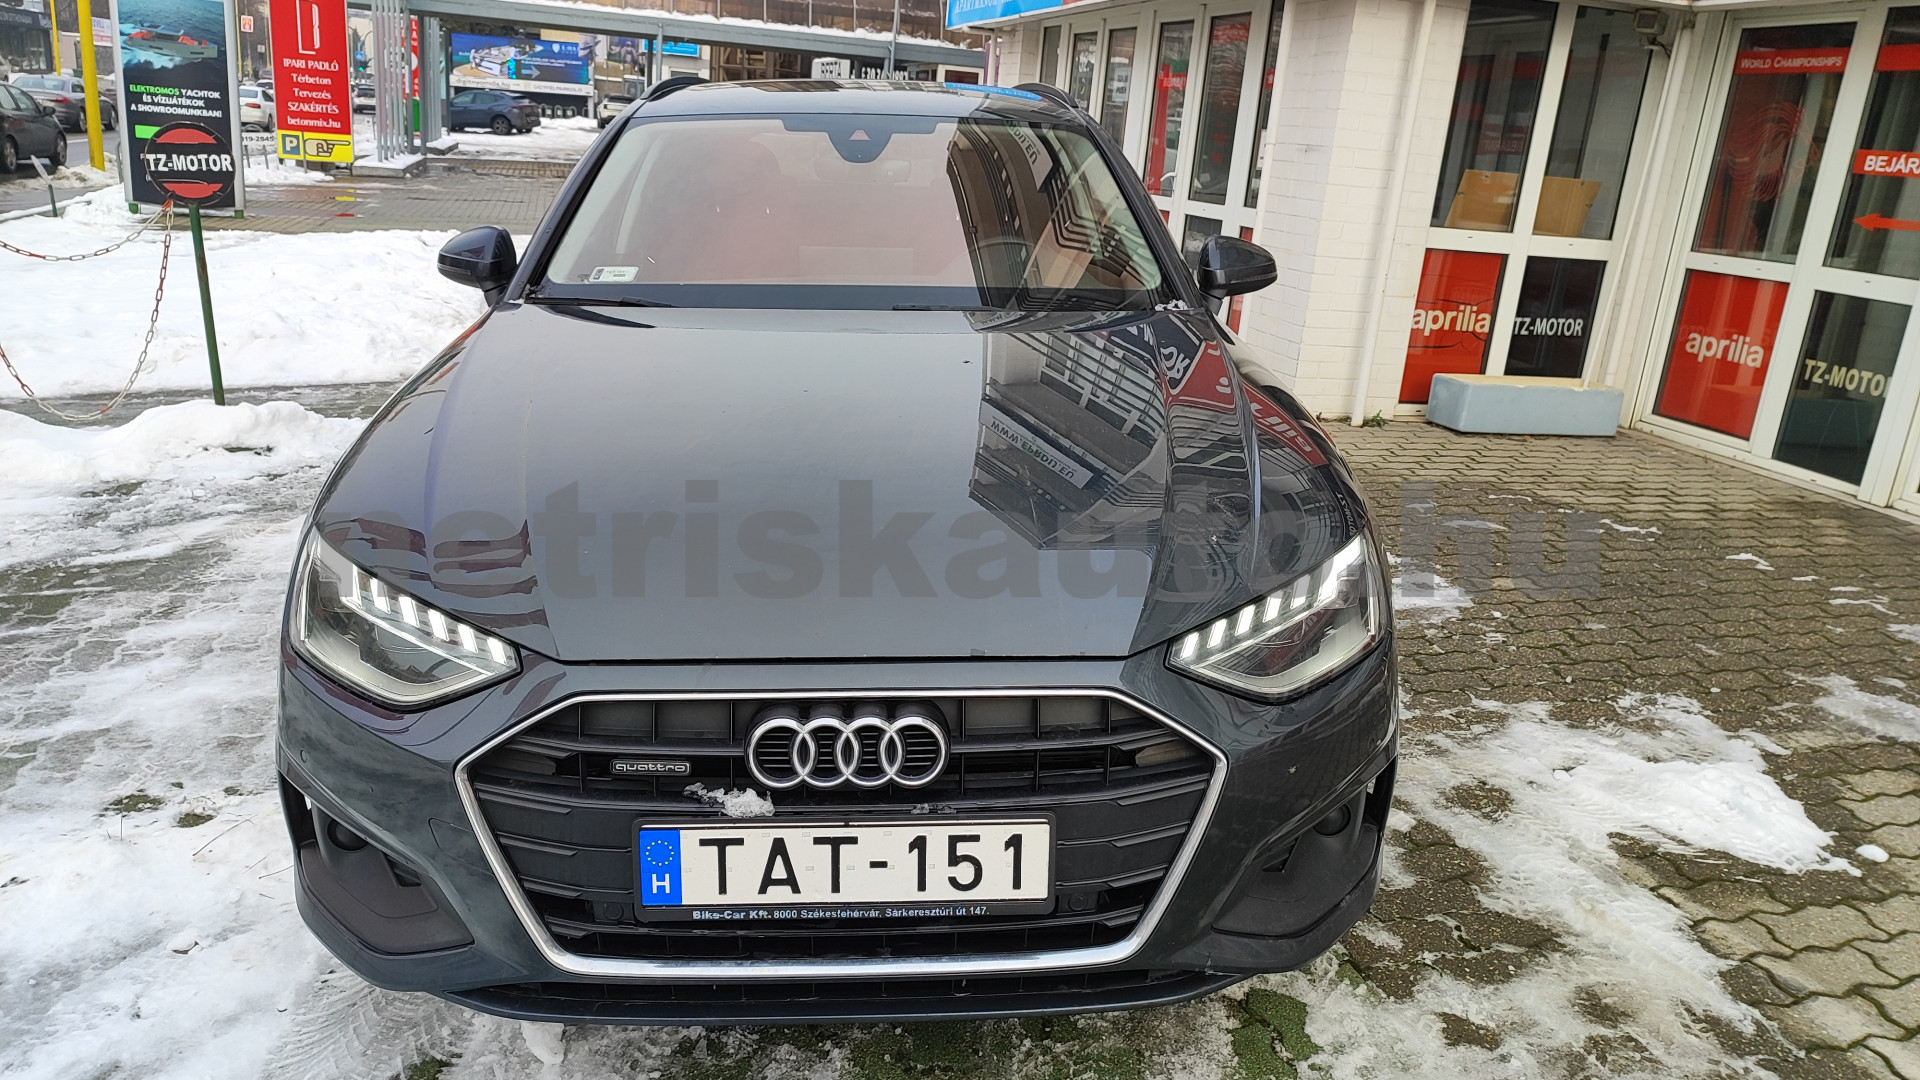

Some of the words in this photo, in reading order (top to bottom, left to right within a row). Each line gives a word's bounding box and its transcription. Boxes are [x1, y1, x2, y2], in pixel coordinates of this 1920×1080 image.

[283, 58, 306, 68] IPARI
[308, 60, 339, 71] PADLÓ
[291, 73, 331, 85] Térbeton
[129, 84, 180, 95] ELEKTROMOS
[180, 88, 221, 99] YACHTOK
[142, 94, 152, 103] ÉS
[293, 88, 332, 100] Tervezés
[130, 103, 137, 111] A
[138, 104, 223, 118] SHOWROOMUNKBAN!
[288, 101, 339, 115] SZAKÉRTÉS
[287, 116, 341, 128] betonmix.hu
[146, 153, 233, 172] TZ-MOTOR
[1863, 153, 1920, 175] BEJÁR
[1411, 304, 1491, 337] aprilia
[1513, 317, 1584, 337] TZ-MOTOR
[1685, 332, 1765, 368] aprilia
[615, 763, 686, 772] quattro
[698, 832, 1024, 896] TAT-151
[651, 873, 671, 895] H
[692, 909, 746, 920] Bike-Car
[749, 909, 772, 919] Kft.
[773, 909, 798, 919] 8000
[800, 907, 882, 920] Székesfehérvár,
[956, 906, 967, 917] út
[969, 906, 990, 917] 147.
